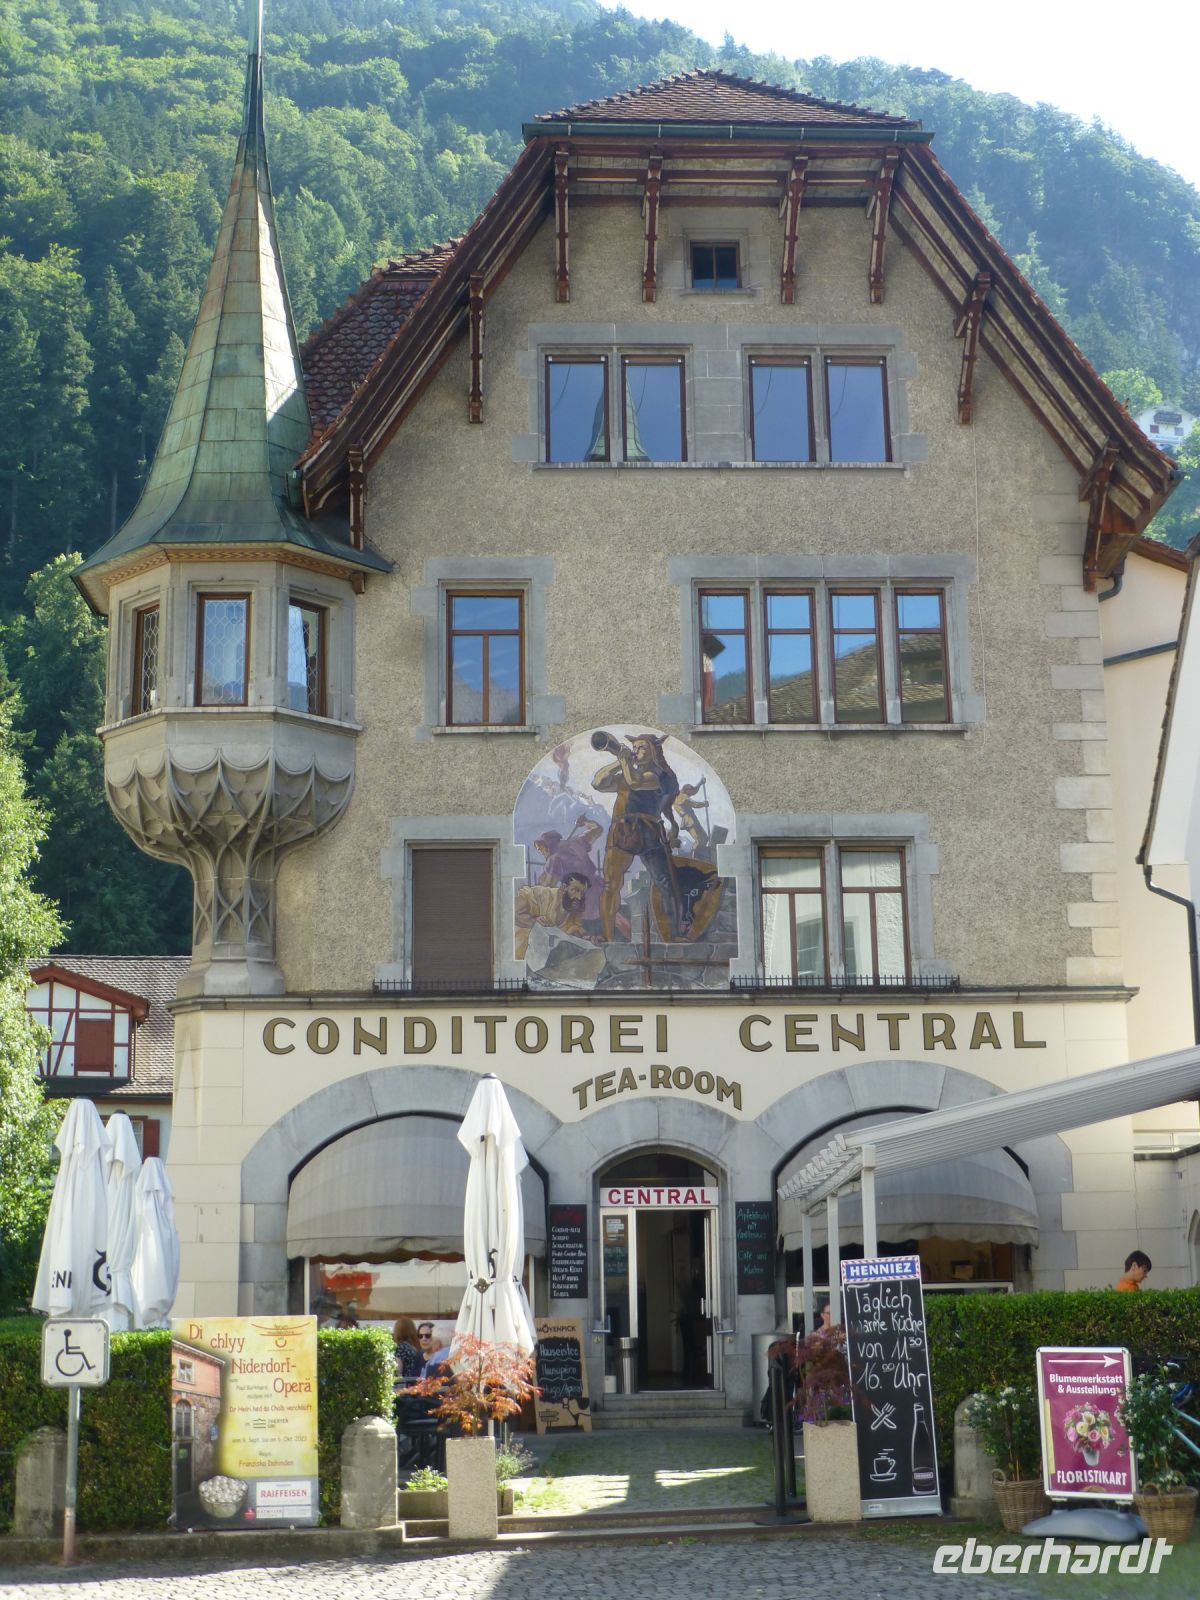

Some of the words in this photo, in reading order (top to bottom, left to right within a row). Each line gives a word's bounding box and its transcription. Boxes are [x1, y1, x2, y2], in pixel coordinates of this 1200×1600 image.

[262, 1014, 668, 1055] CONDITOREI
[738, 1011, 1047, 1053] CENTRAL
[572, 1064, 742, 1111] TEA-ROOM
[608, 1188, 711, 1205] CENTRAL
[849, 1262, 913, 1277] HENNIEZ
[846, 1281, 912, 1320] Täglich
[189, 1323, 203, 1340] Di
[851, 1318, 888, 1334] arme
[210, 1333, 245, 1353] chlyy
[857, 1342, 885, 1360] von
[273, 1377, 312, 1397] Operä
[893, 1362, 927, 1397] Uhr
[1049, 1373, 1124, 1384] Blumenwerkstatt
[1057, 1384, 1065, 1394] &
[1057, 1470, 1128, 1486] FLORISTIKART
[260, 1489, 307, 1498] RAIFFEISEN
